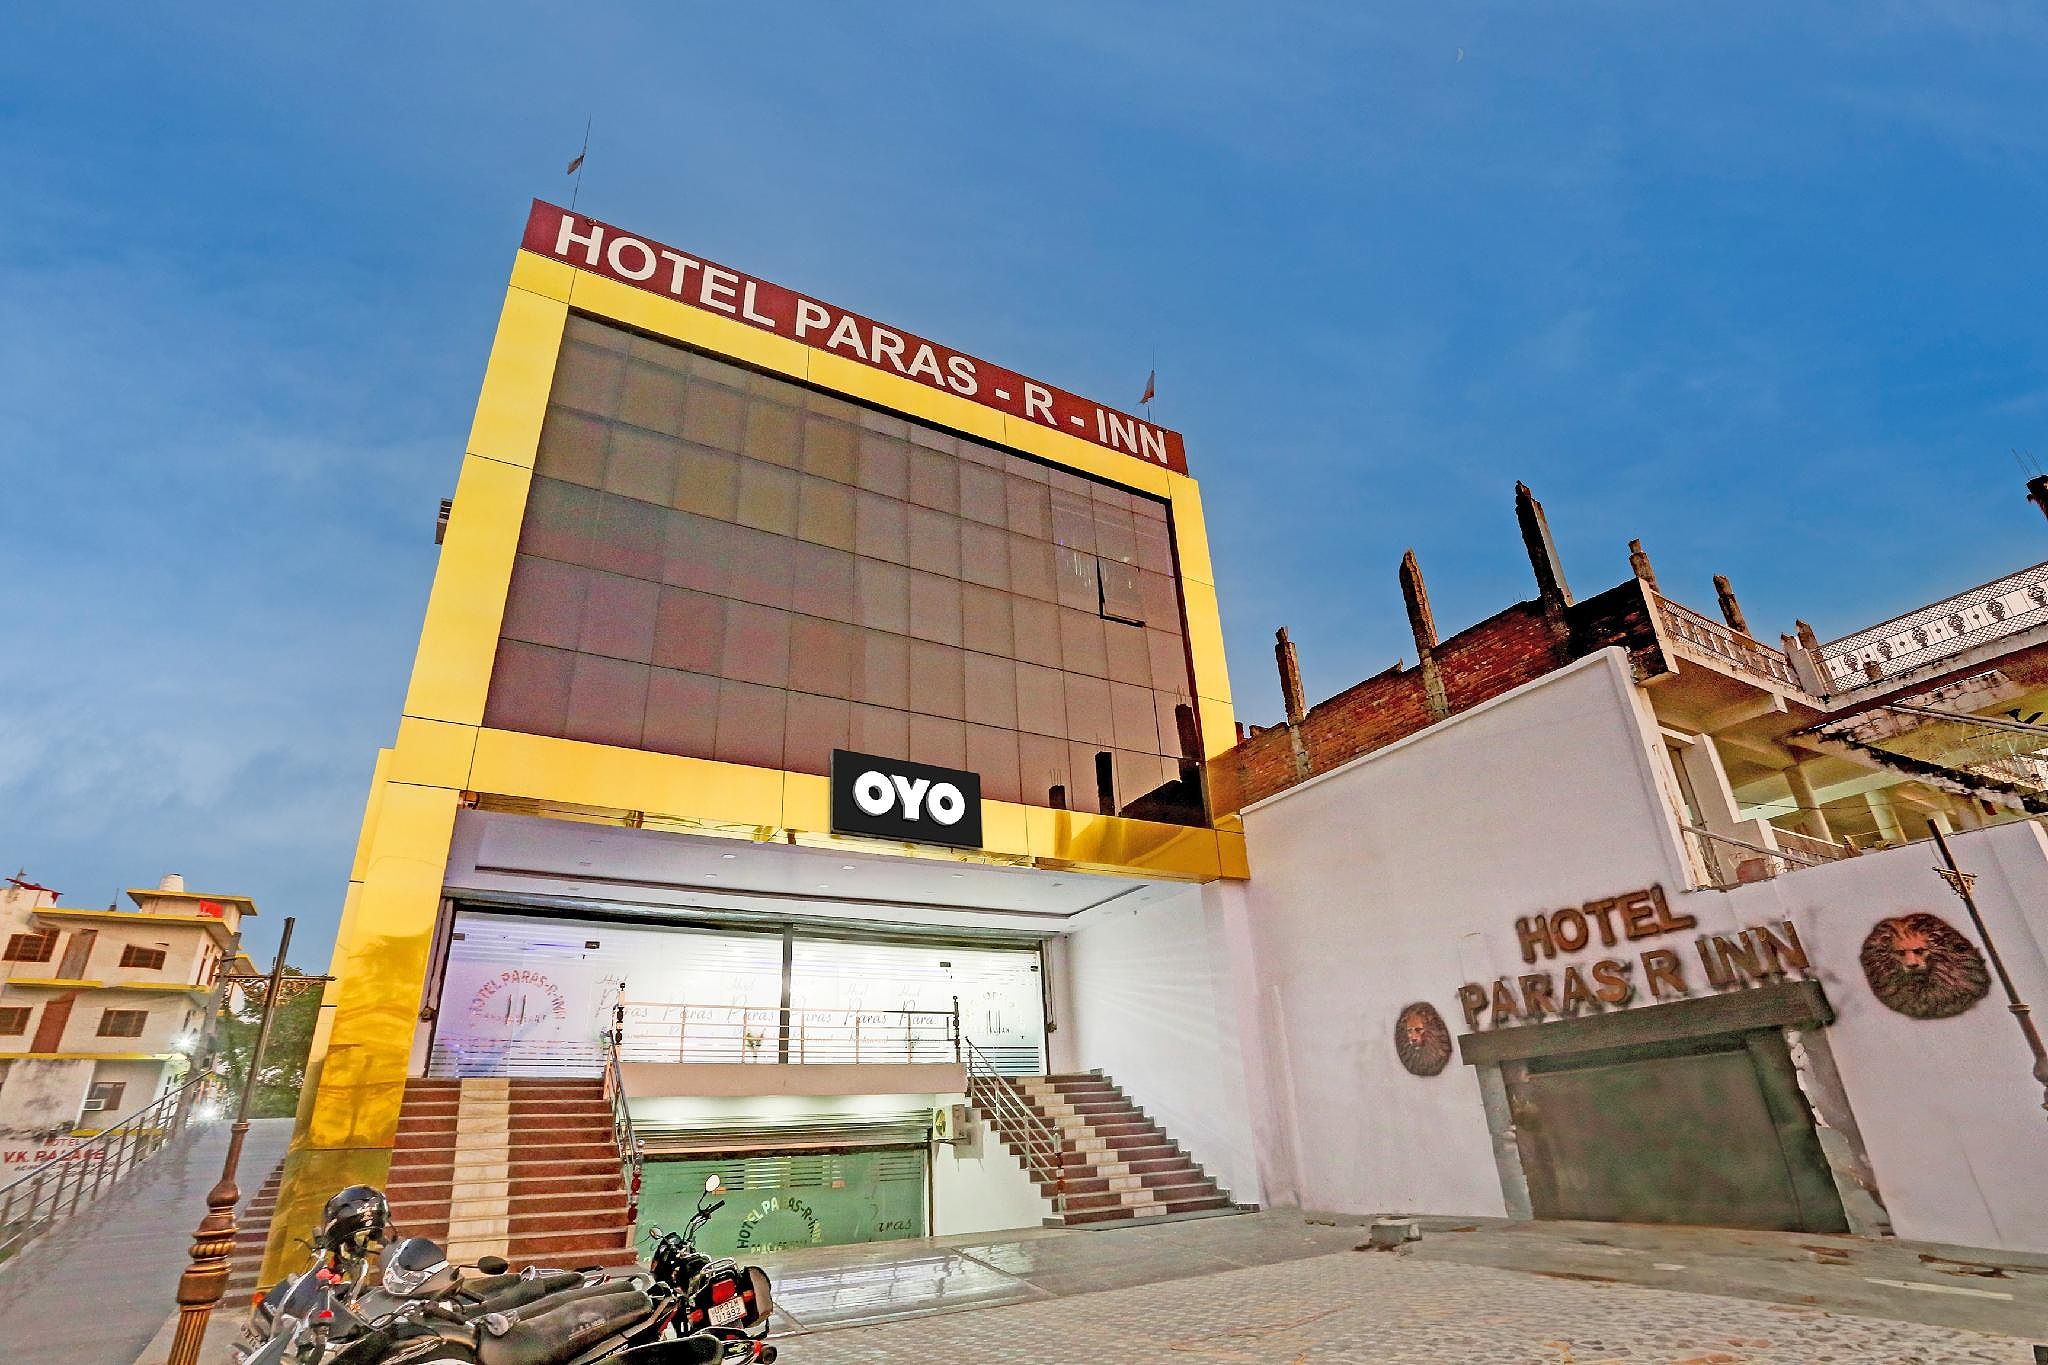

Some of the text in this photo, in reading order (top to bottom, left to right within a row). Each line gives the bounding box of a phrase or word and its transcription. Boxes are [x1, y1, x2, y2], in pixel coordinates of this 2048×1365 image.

[554, 214, 776, 328] HOTEL
[795, 298, 978, 396] PARAS
[1024, 381, 1057, 426] R
[1097, 408, 1168, 464] INN
[852, 770, 966, 826] OYO
[1515, 883, 1696, 964] HOTEL
[1458, 919, 1810, 1029] PARAS R INN
